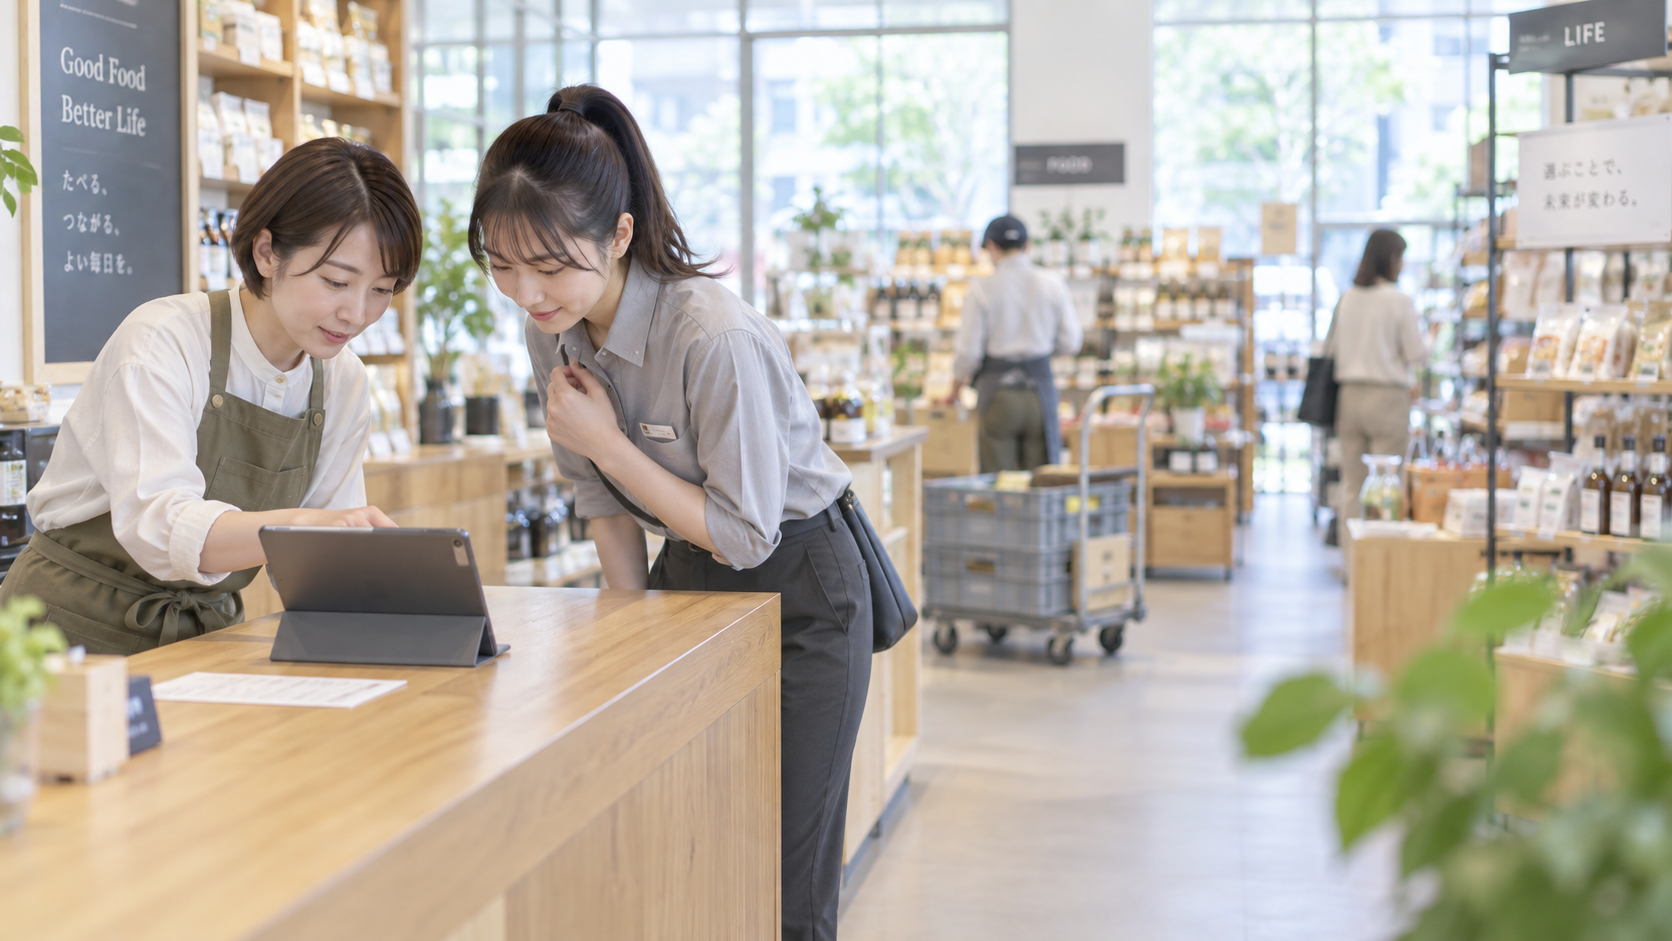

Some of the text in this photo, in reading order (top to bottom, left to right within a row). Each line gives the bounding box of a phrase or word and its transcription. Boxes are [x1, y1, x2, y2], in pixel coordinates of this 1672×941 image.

[1564, 21, 1606, 47] LIFE
[60, 46, 146, 92] Good Food
[61, 94, 146, 137] Better Life
[1046, 155, 1094, 175] FOOD
[1543, 158, 1622, 181] 選ぶことで、
[62, 169, 107, 196] たべる、
[63, 211, 120, 237] つながる、
[64, 250, 133, 276] よい毎日を。
